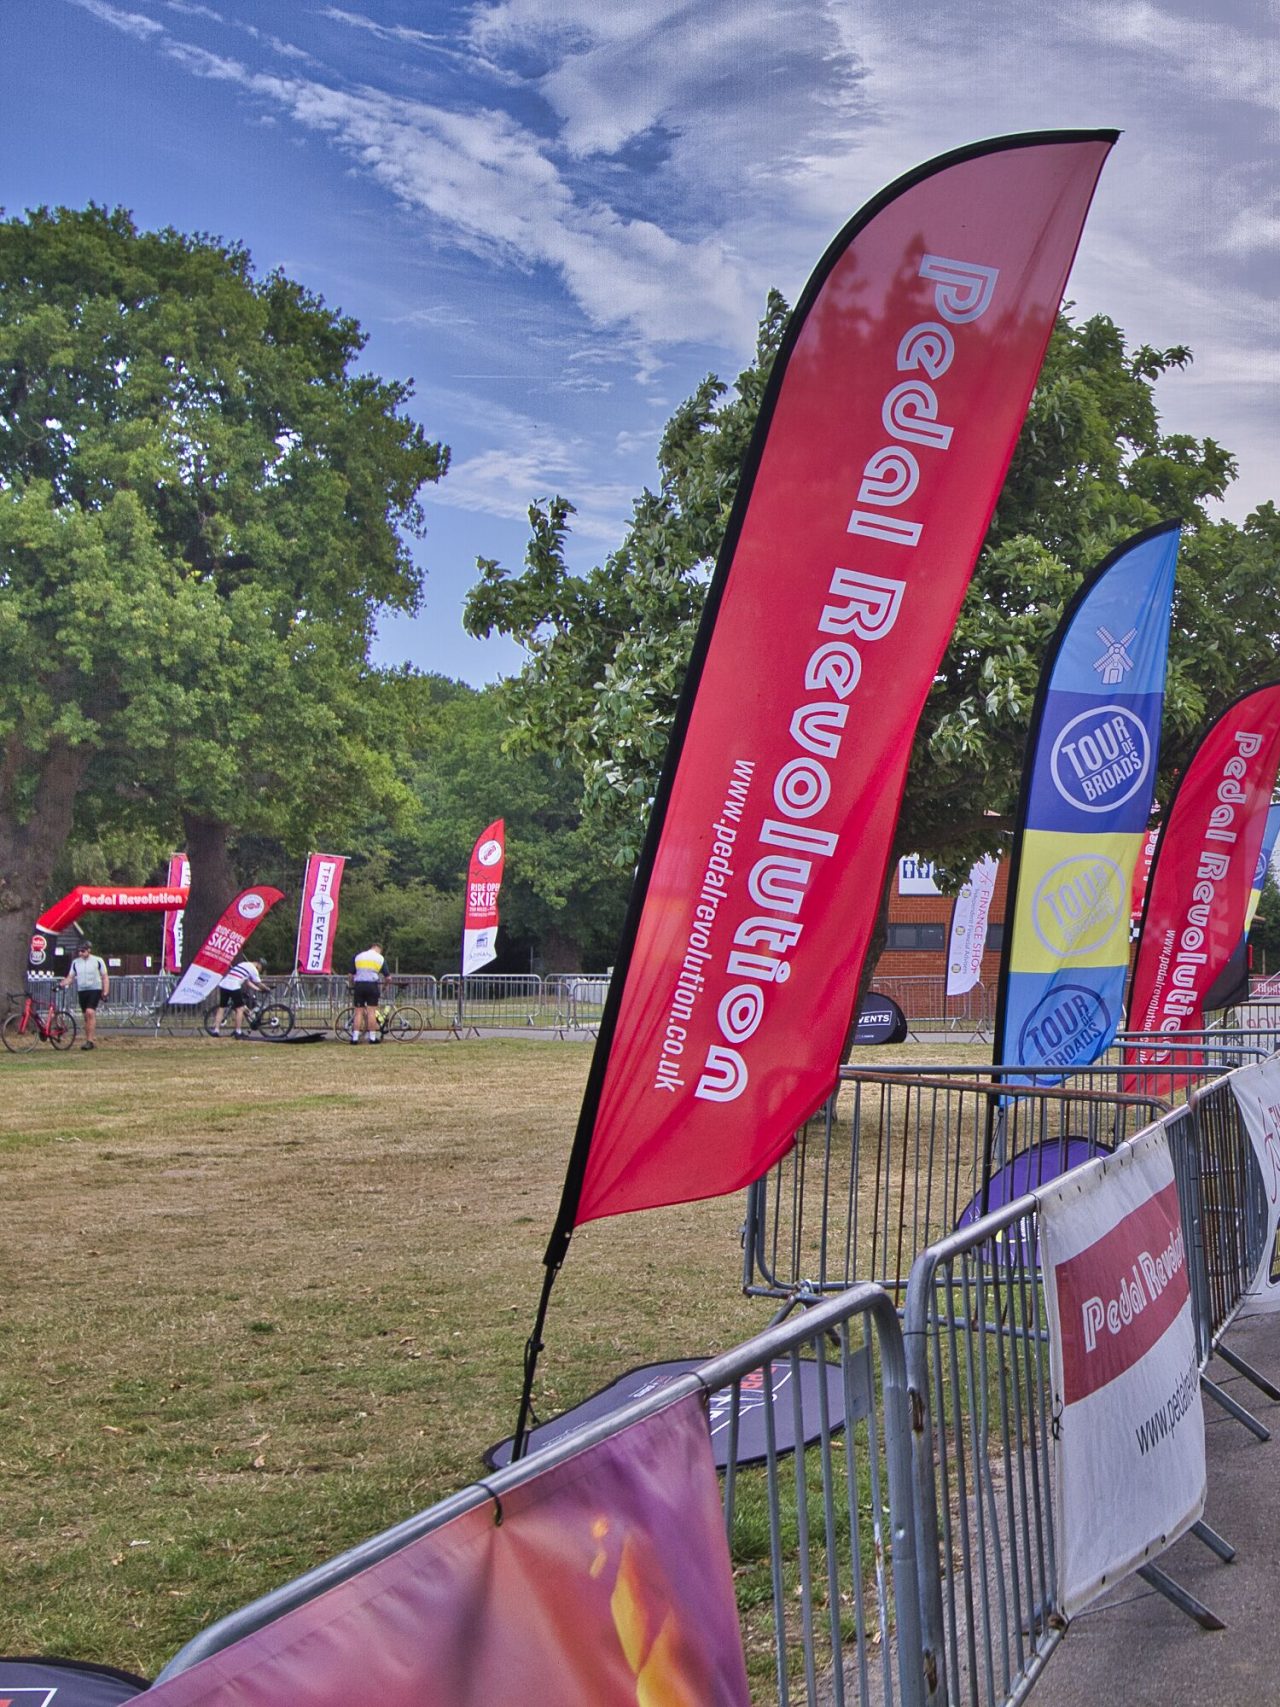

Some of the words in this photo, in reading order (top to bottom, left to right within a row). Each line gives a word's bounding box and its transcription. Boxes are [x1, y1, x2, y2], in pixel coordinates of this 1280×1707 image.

[847, 254, 999, 546] Pedal
[1061, 716, 1130, 779] TOUR
[1121, 738, 1136, 754] DE
[1081, 751, 1142, 802] BROADS
[1205, 731, 1263, 843] Pedal
[694, 567, 906, 1102] Revolution
[82, 894, 117, 906] Pedal
[119, 893, 183, 906] Revolution
[319, 866, 331, 892] TPR
[470, 883, 486, 892] RIDE
[653, 759, 756, 1093] www.pedalrevolution.co.uk
[973, 890, 990, 940] FINANCE
[208, 931, 241, 956] SKIES
[311, 916, 326, 968] EVENTS
[858, 1014, 890, 1024] VENTS
[1026, 994, 1089, 1058] TOUR
[1081, 1265, 1147, 1354] Pedal
